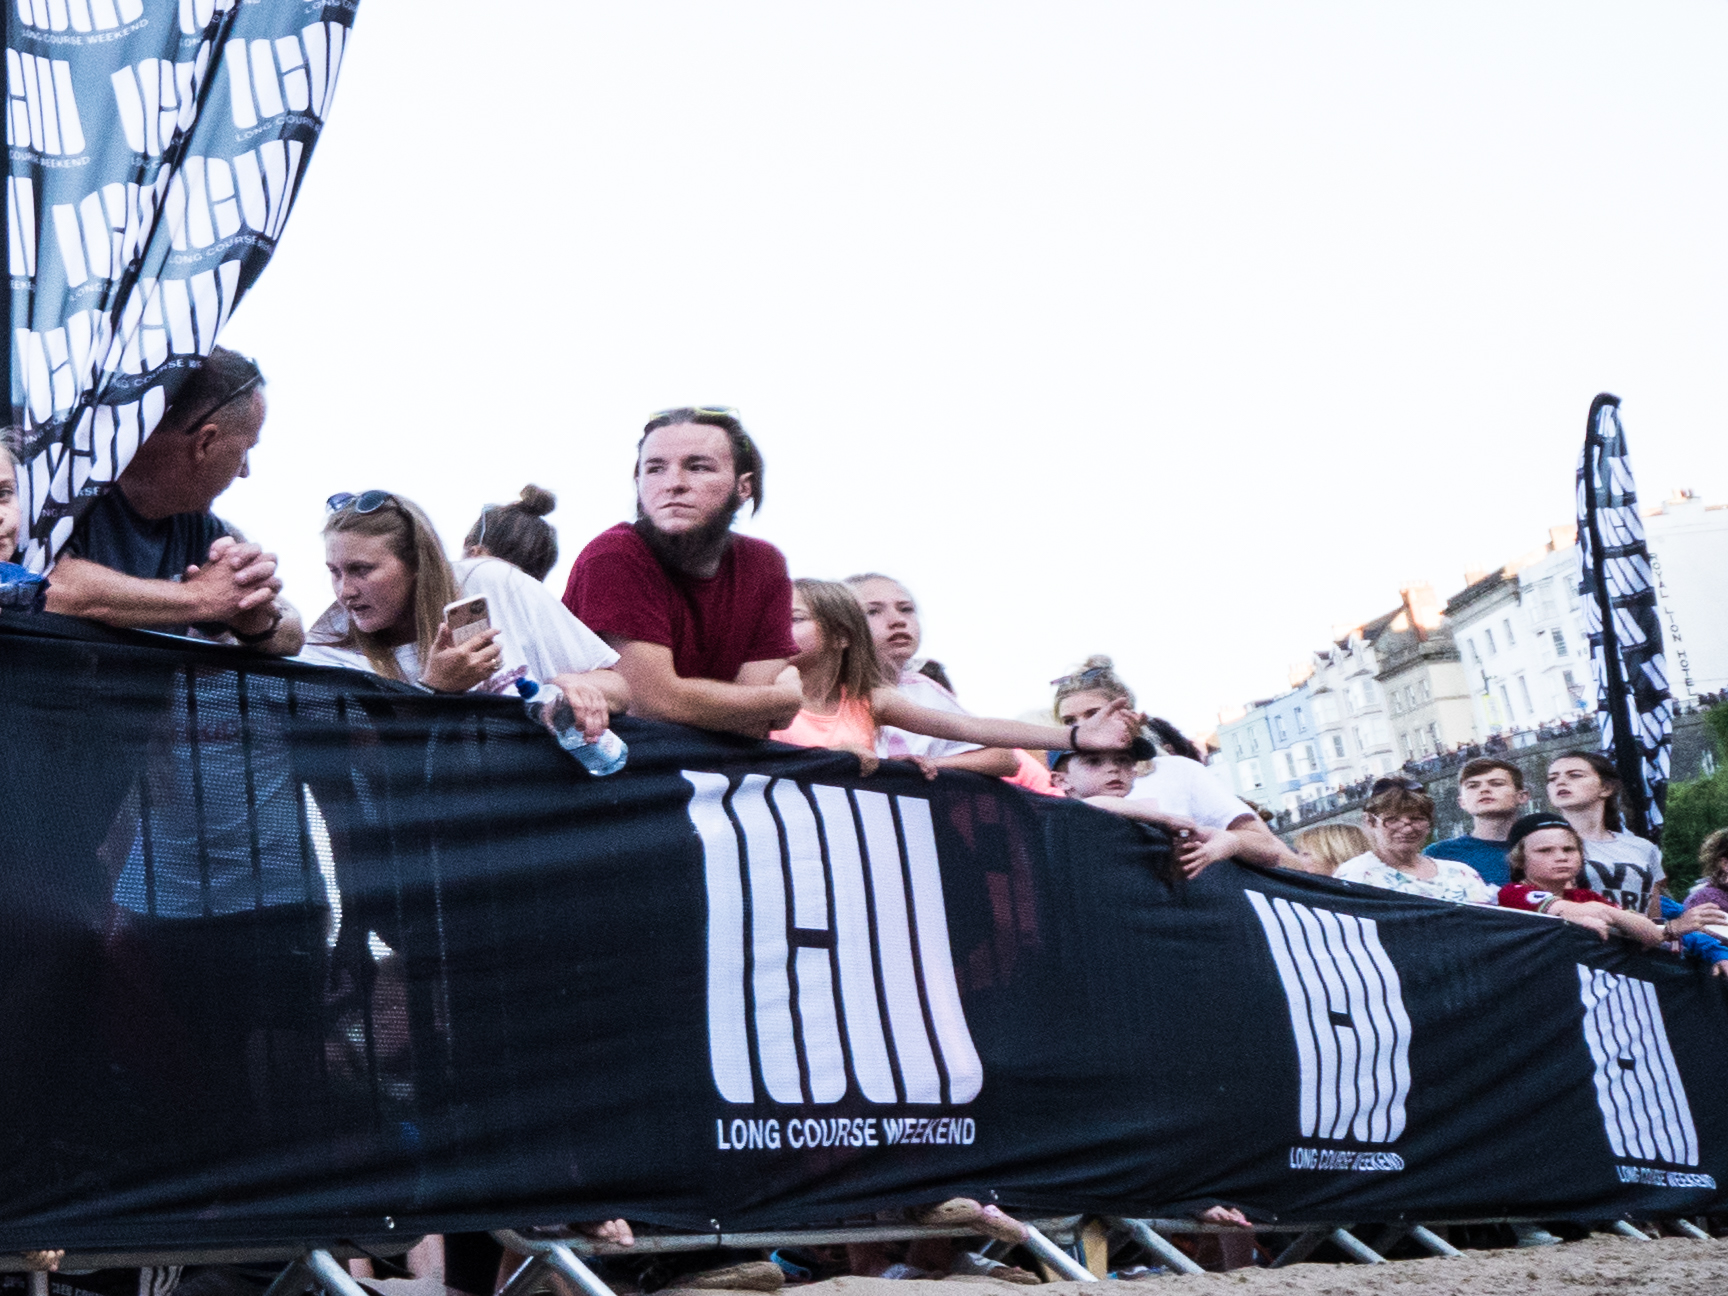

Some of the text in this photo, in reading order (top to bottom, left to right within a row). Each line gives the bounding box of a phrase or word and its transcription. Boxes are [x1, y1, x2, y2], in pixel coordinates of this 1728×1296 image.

[86, 18, 149, 45] WEEKEND
[1650, 553, 1697, 696] ROYAL LION HOTEL
[717, 1117, 976, 1150] LONG COURSE WEEKEND
